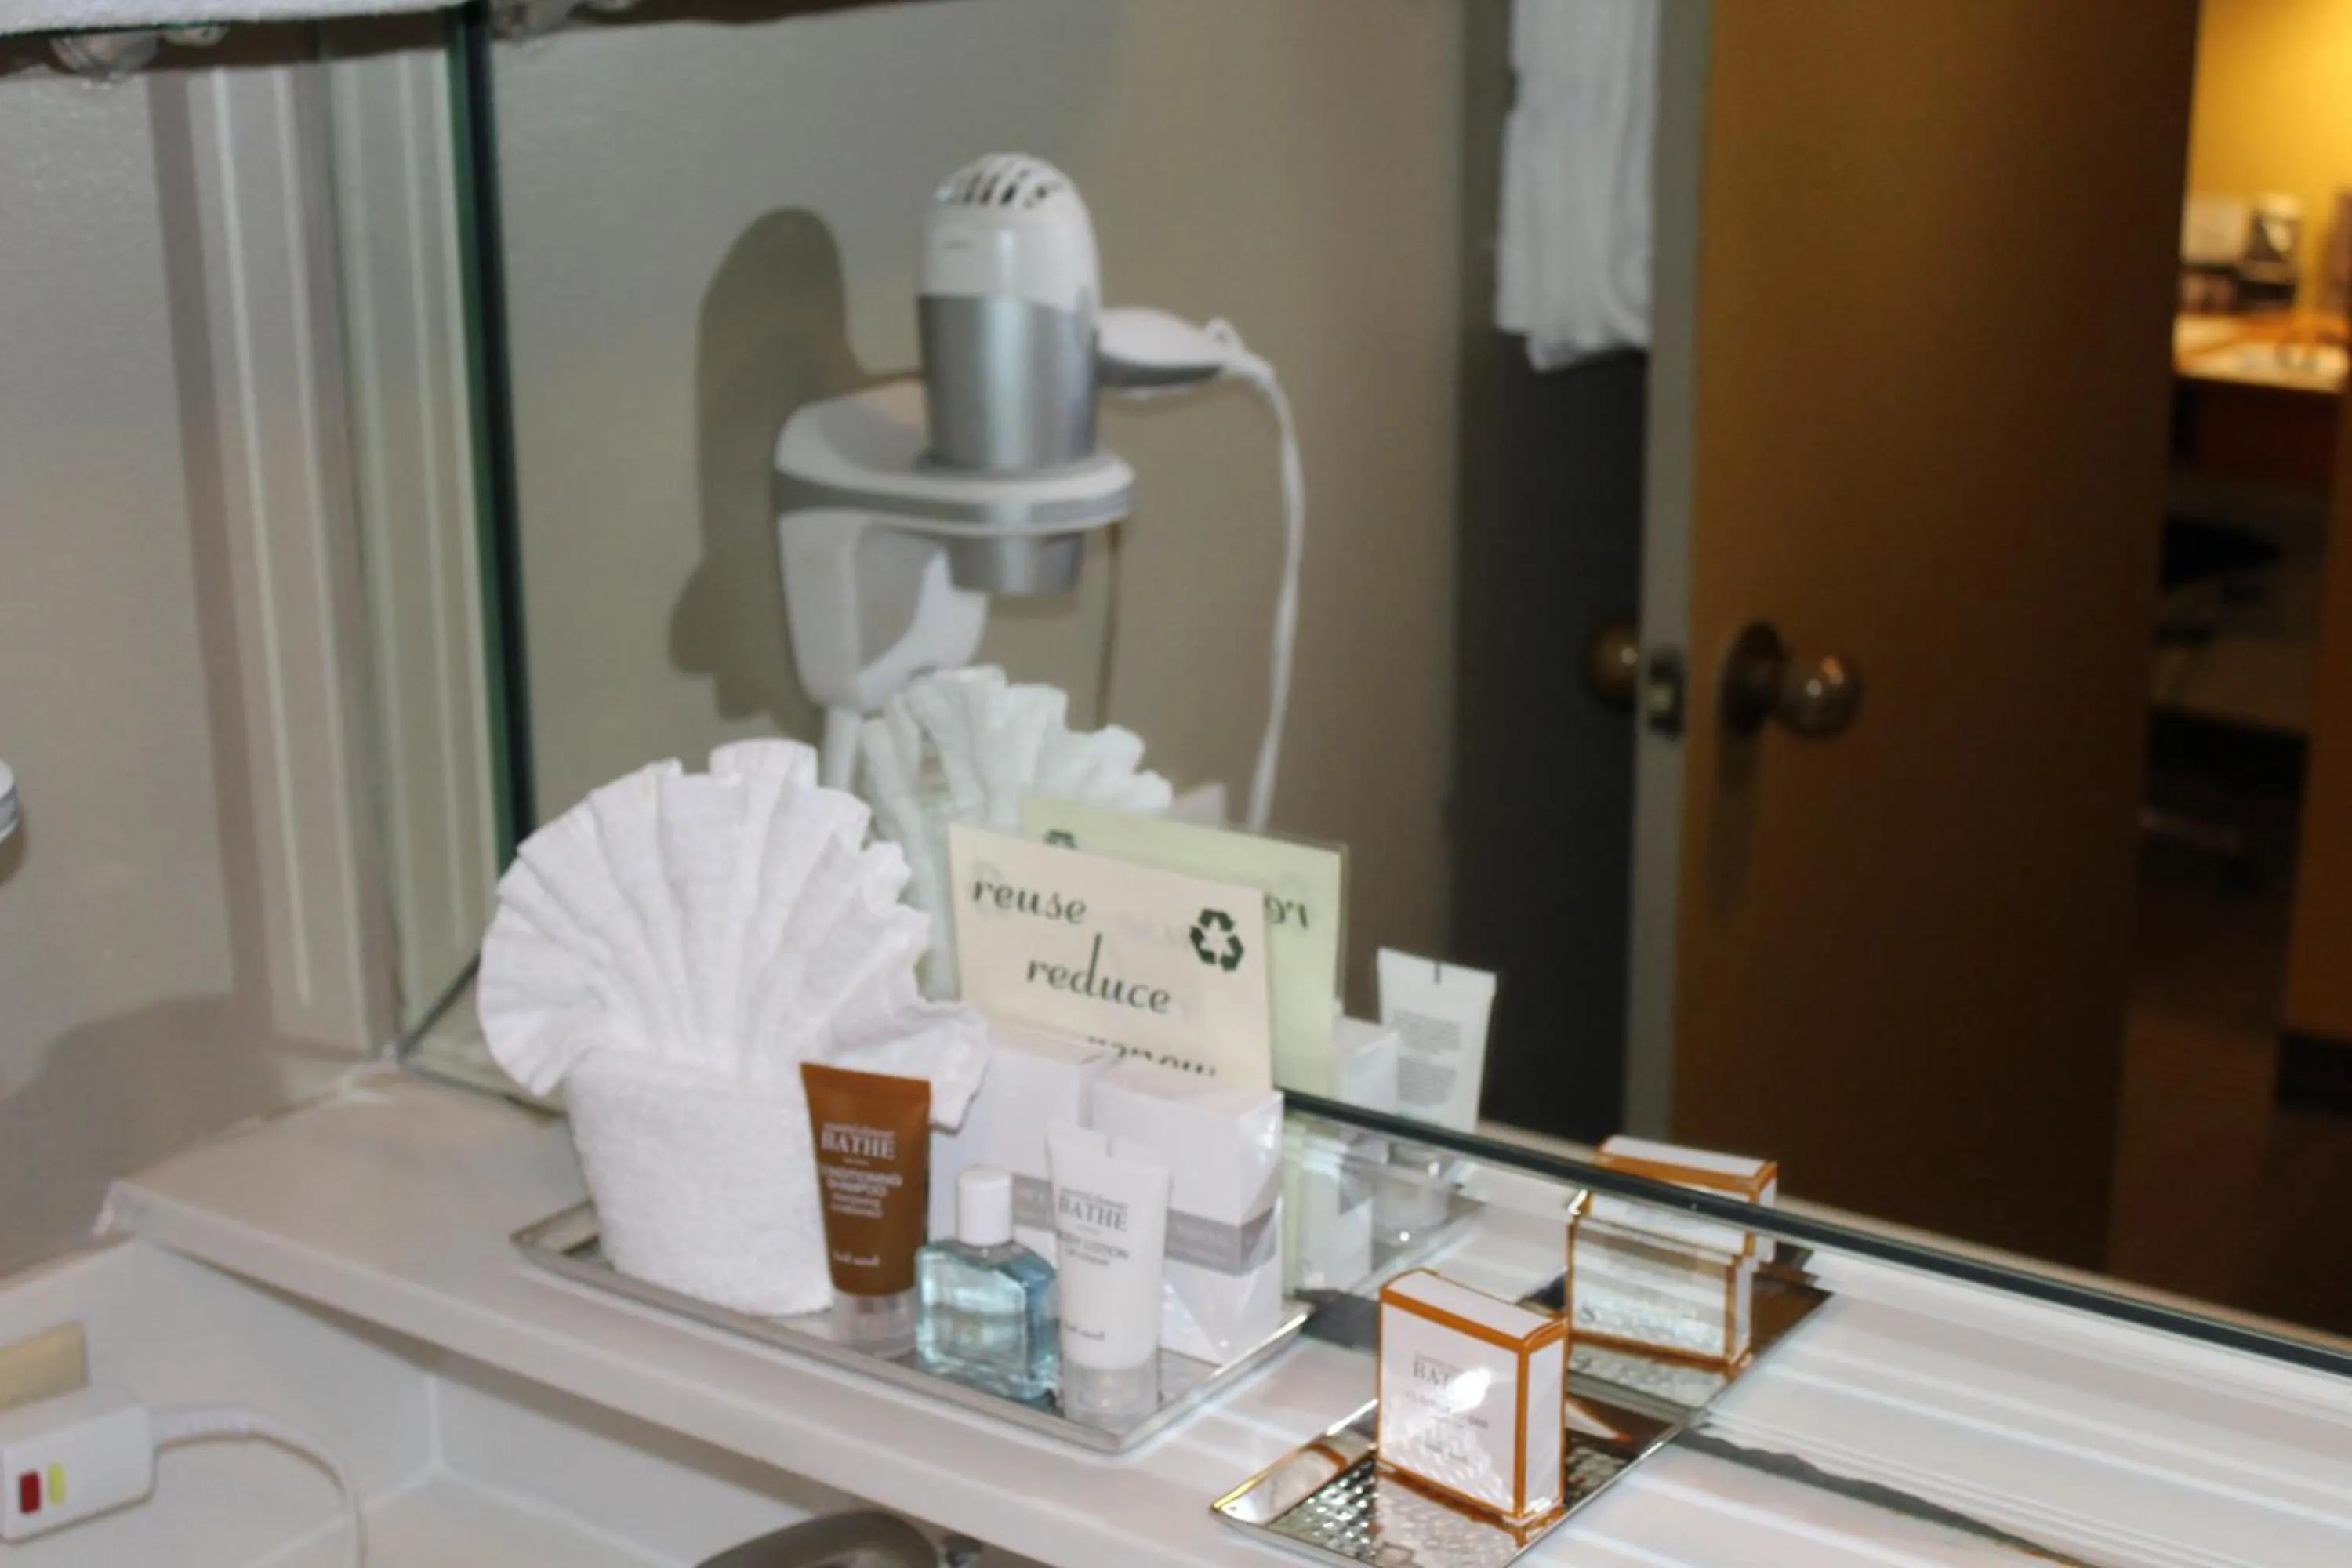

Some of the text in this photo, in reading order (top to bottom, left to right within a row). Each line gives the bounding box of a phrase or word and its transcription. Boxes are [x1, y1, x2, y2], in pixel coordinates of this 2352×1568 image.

[972, 877, 1087, 925] reuse
[1025, 932, 1171, 1014] reduce
[821, 1129, 897, 1160] BATHE
[1058, 1196, 1129, 1232] BATHE
